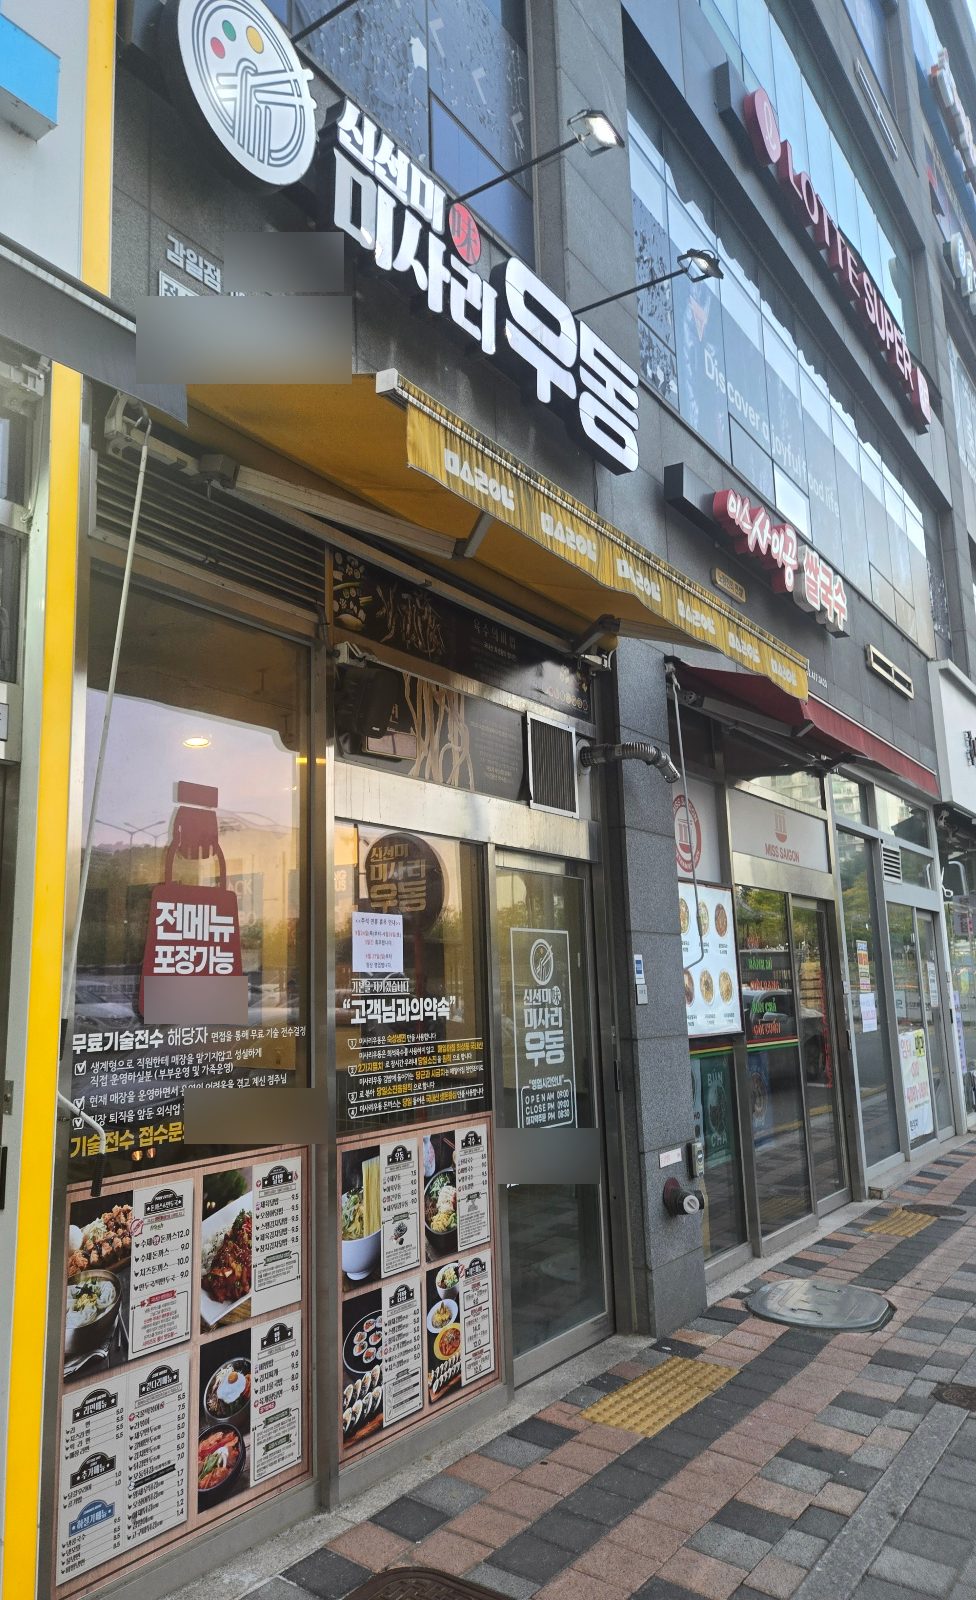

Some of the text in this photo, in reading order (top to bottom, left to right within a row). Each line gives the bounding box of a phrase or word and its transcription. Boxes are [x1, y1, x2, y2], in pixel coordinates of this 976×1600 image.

[337, 100, 447, 235] 신선미
[167, 234, 222, 293] 감일점
[780, 140, 915, 392] LOTTE SUPER
[333, 147, 640, 473] 미사리 우동
[704, 345, 760, 432] Discover
[727, 490, 847, 632] 미스사이공 쌀국수
[765, 842, 800, 863] MISS SAIGON
[370, 879, 427, 913] 우동
[155, 902, 235, 943] 전메뉴
[153, 945, 235, 975] 포장가능
[524, 1007, 563, 1030] 미사리
[72, 1029, 164, 1054] 무료기술전수
[167, 1026, 208, 1046] 해당자
[211, 1030, 233, 1043] 면접을
[234, 1030, 249, 1041] 통해
[250, 1029, 264, 1040] 무료
[266, 1028, 280, 1038] 기술
[525, 1030, 565, 1067] 우동
[90, 1059, 134, 1074] 생계형으로
[136, 1056, 169, 1069] 직원한테
[171, 1053, 195, 1065] 매장을
[234, 1048, 262, 1060] 성실하게
[90, 1074, 108, 1087] 직접
[110, 1071, 153, 1086] 운영하실분
[192, 1065, 200, 1077] 및
[89, 1094, 108, 1108] 현재
[110, 1091, 136, 1104] 매장을
[137, 1085, 179, 1100] 운영하면서
[252, 1075, 266, 1086] 계신
[267, 1073, 287, 1086] 점주님
[525, 1093, 546, 1105] OPEN
[109, 1104, 181, 1124] 퇴직을 앞둔 외식업
[525, 1104, 546, 1116] CLOSE
[177, 1228, 190, 1239] 12.0
[140, 1242, 190, 1261] 수제돈까스 9.0
[139, 1256, 190, 1277] 치즈돈까스 10.0
[180, 1270, 189, 1279] 9.0
